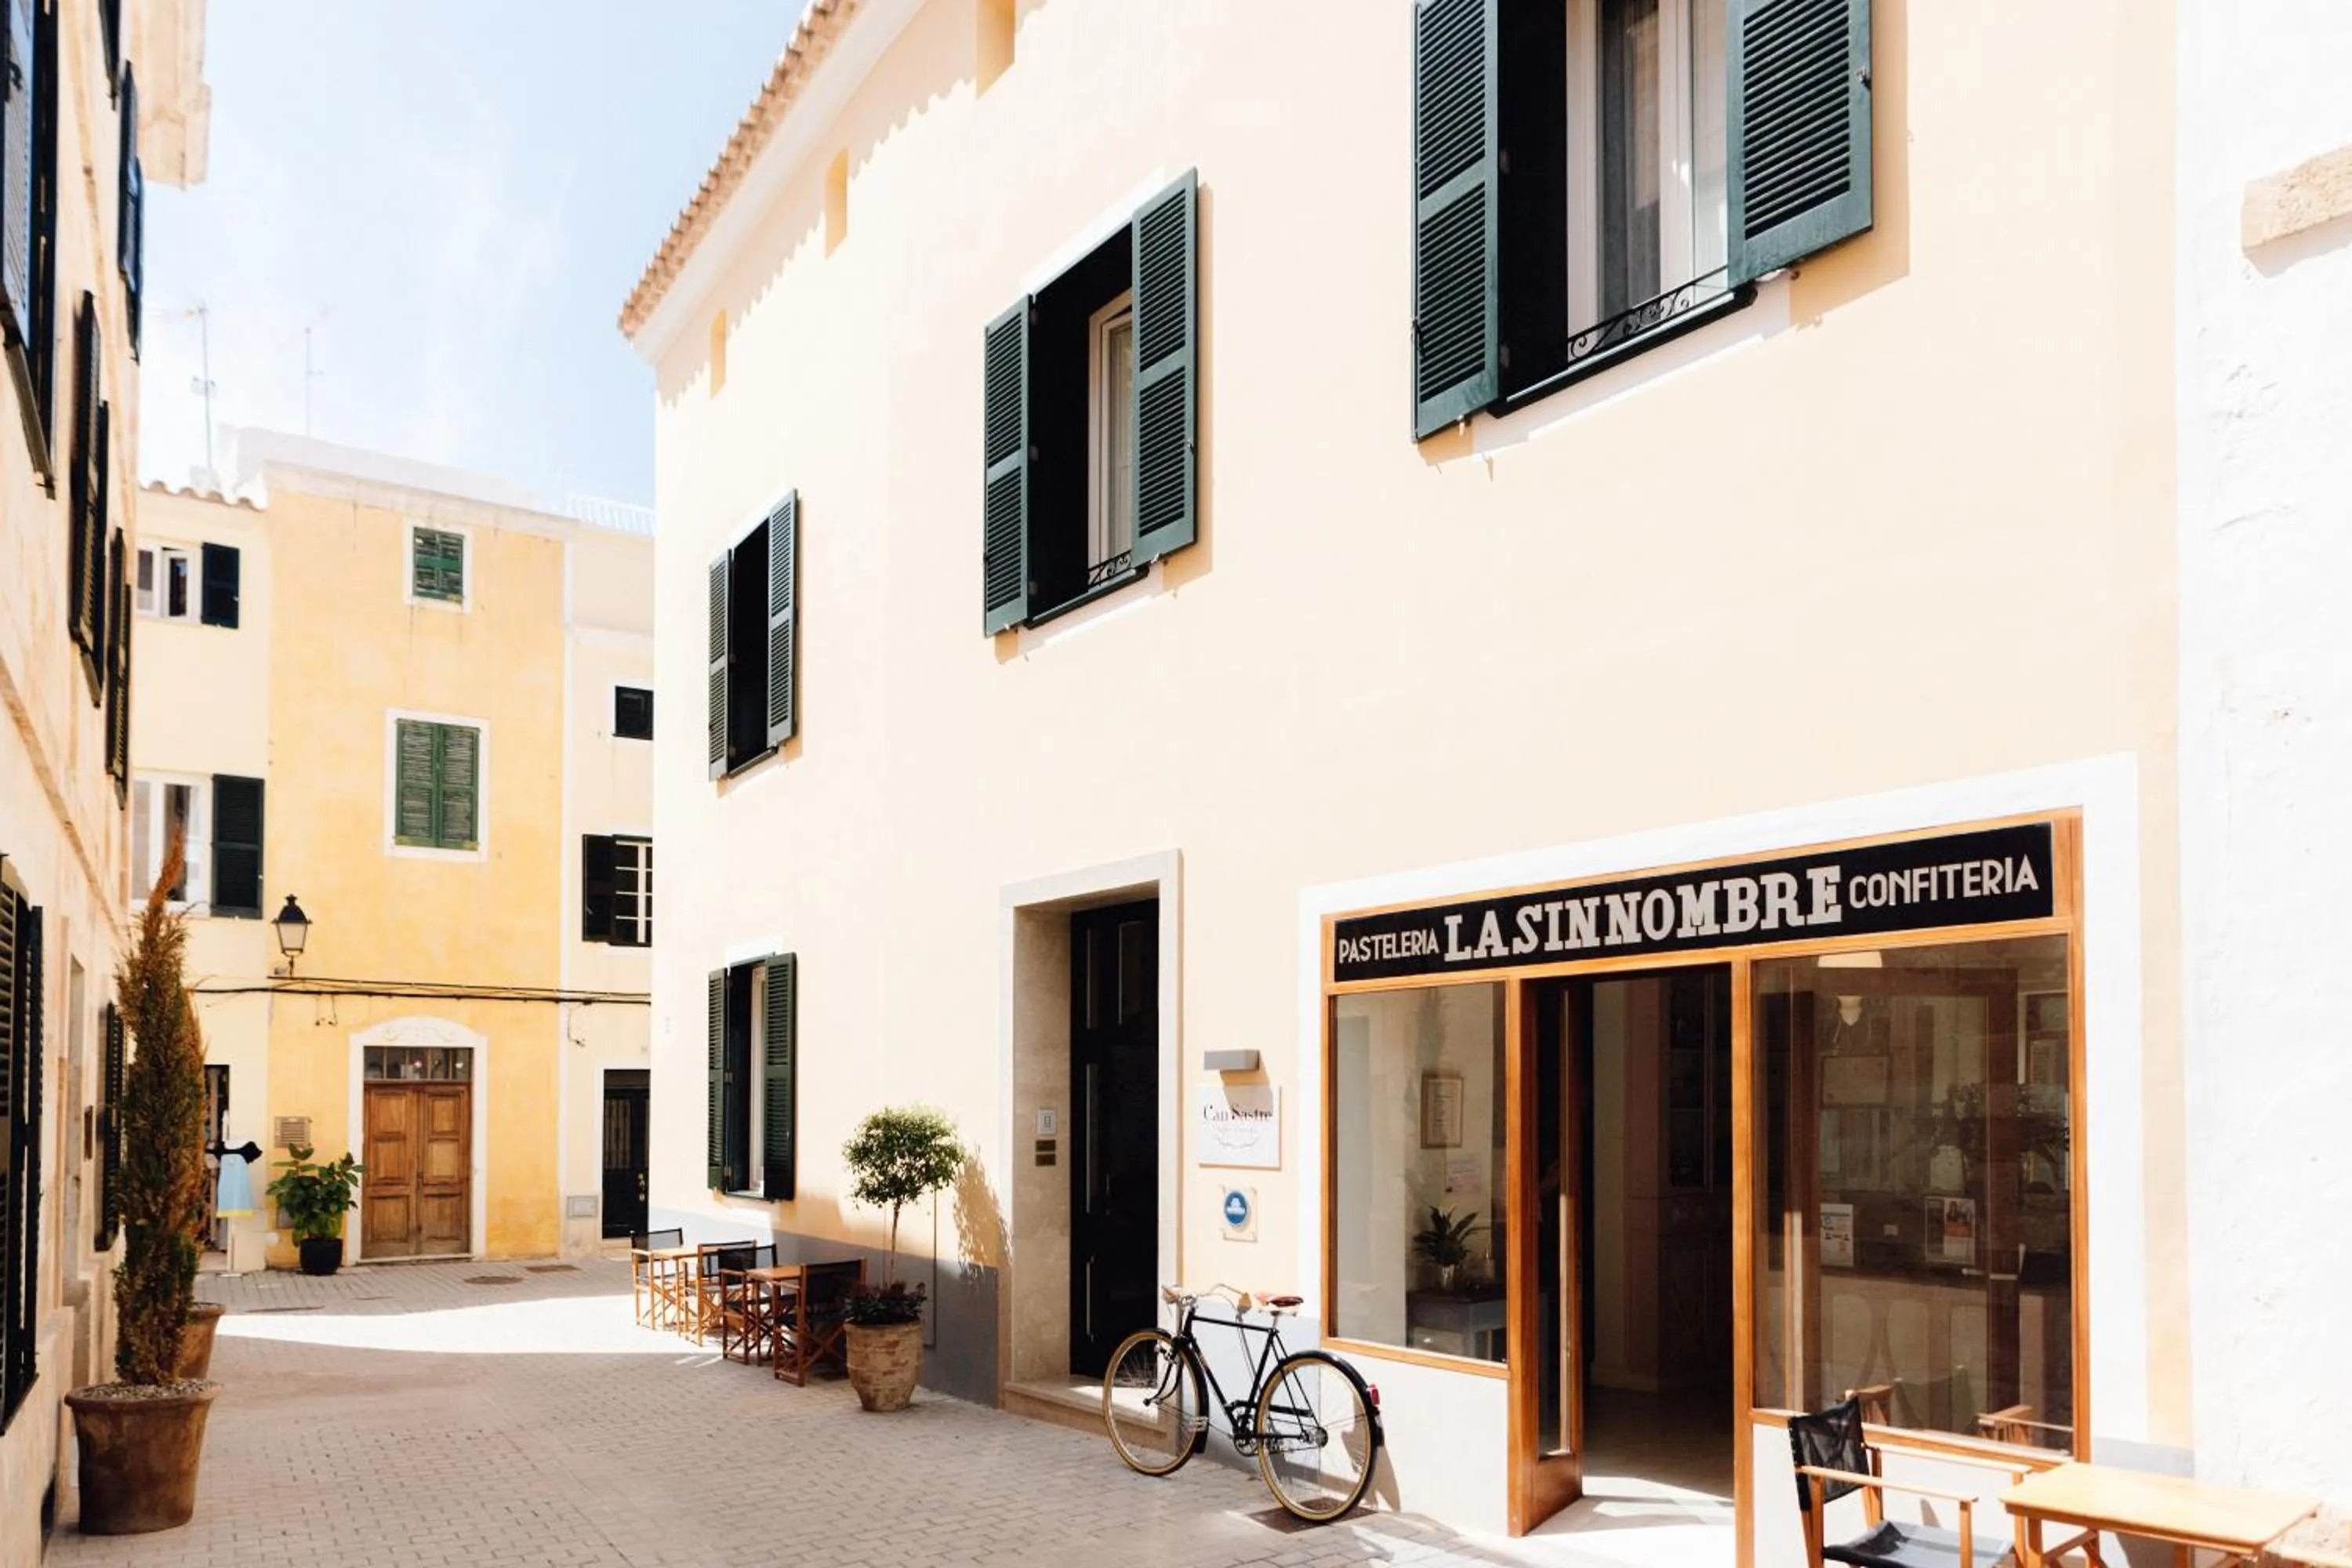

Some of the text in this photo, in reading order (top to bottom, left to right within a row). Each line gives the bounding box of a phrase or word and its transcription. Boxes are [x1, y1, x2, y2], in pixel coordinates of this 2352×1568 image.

[1338, 928, 1439, 964] PASTELERIA
[1849, 855, 2039, 909] CONFITERIA
[1203, 1103, 1229, 1121] Can
